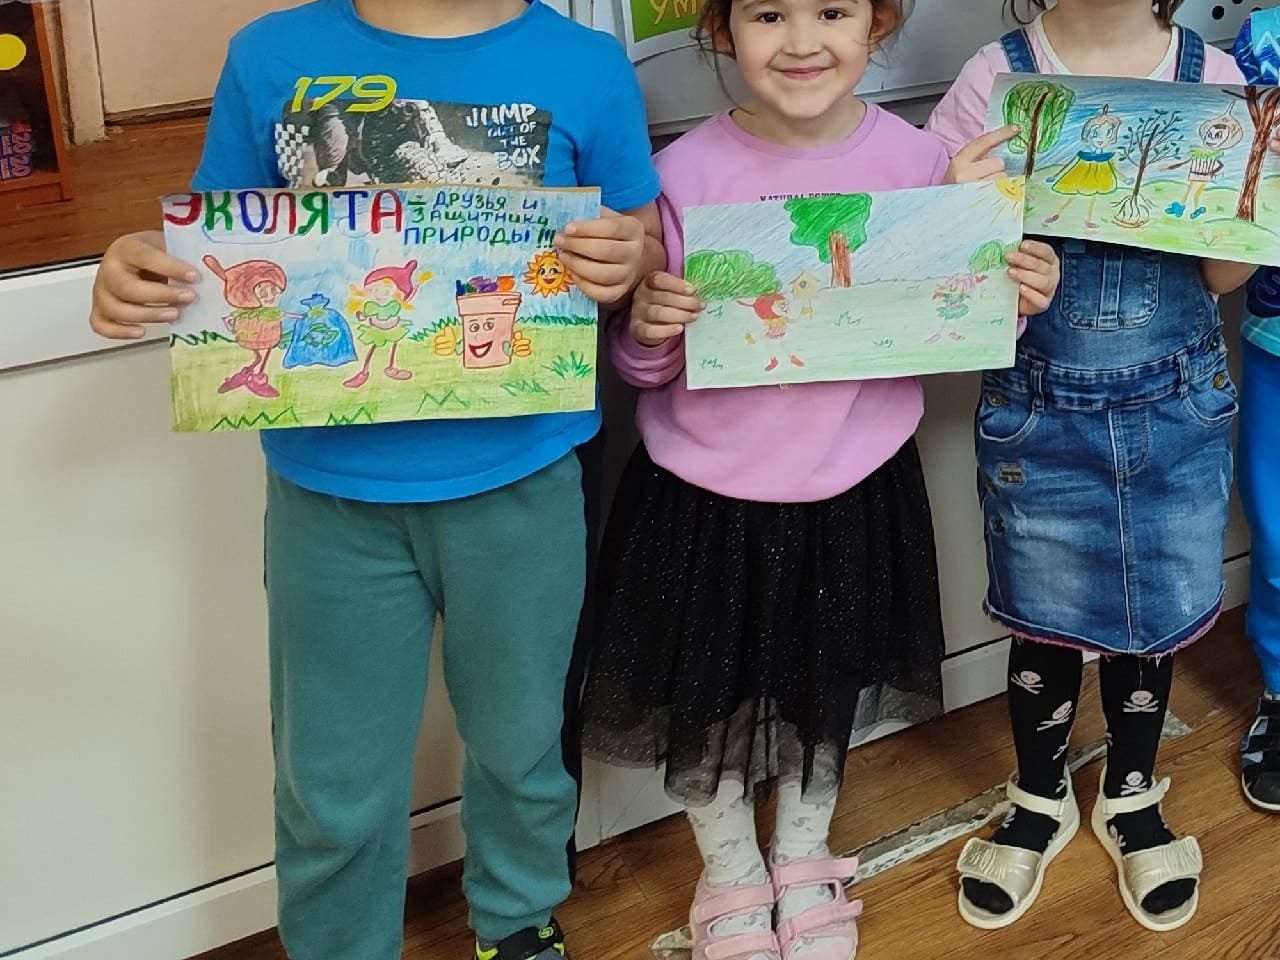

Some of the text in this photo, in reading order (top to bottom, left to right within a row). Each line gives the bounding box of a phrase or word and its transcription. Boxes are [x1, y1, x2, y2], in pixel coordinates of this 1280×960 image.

[290, 74, 397, 114] 179
[465, 103, 537, 128] JUMP
[519, 122, 537, 133] OF
[495, 145, 540, 171] BOX
[164, 190, 404, 235] ЭКОЛЯТА
[404, 226, 530, 245] ПРИРОДЫ
